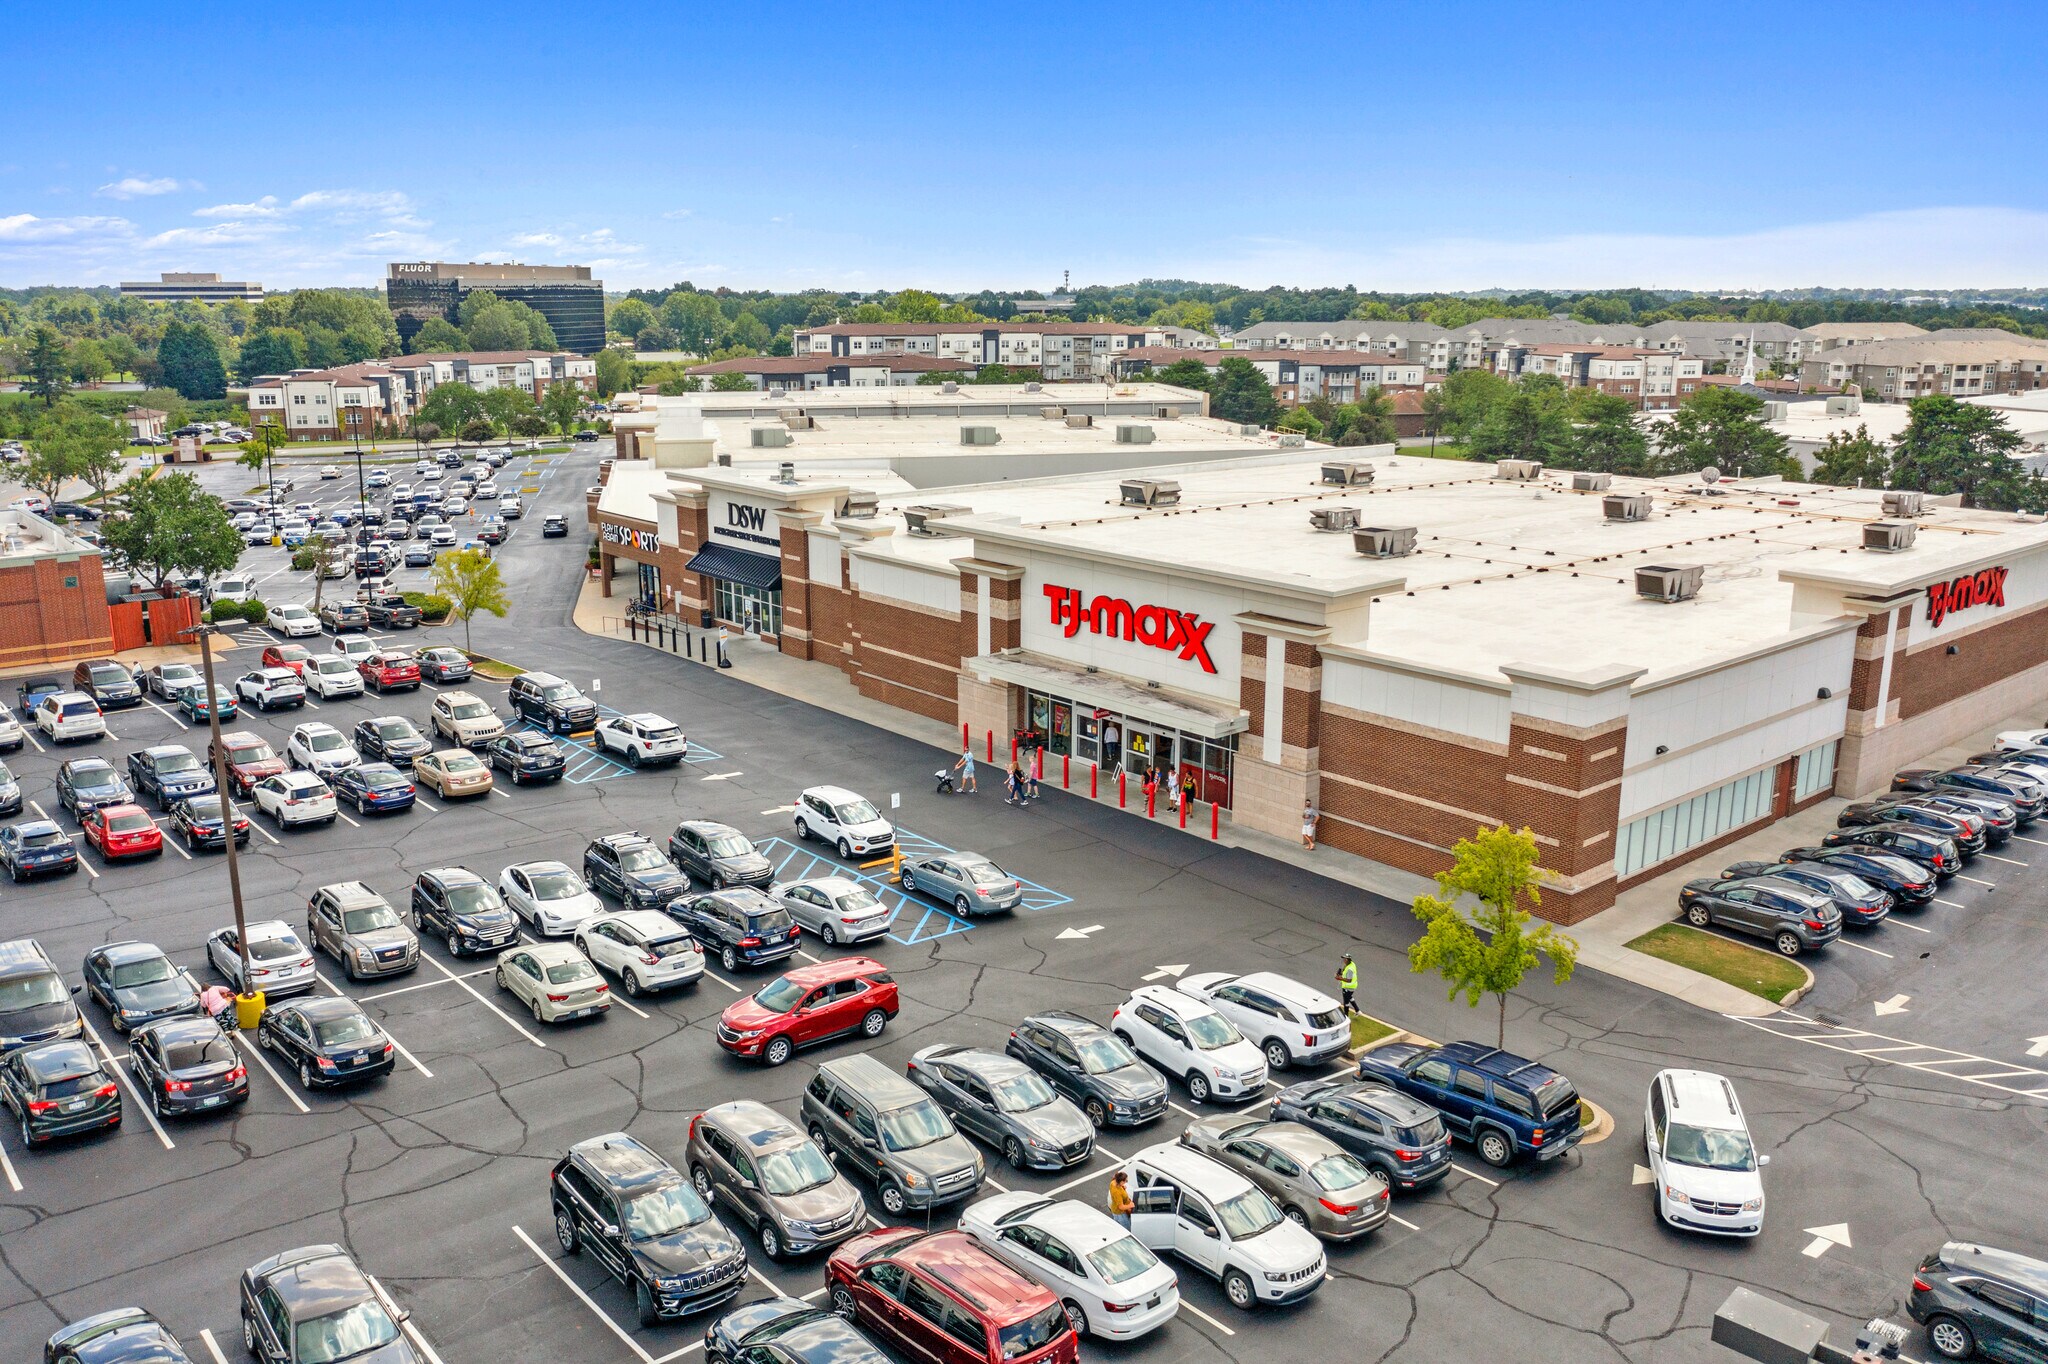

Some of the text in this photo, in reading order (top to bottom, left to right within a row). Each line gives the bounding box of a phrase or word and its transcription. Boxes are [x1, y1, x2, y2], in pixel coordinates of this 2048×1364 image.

[399, 264, 432, 273] FLUOR
[727, 502, 767, 531] DSW
[619, 526, 660, 554] SPORTS
